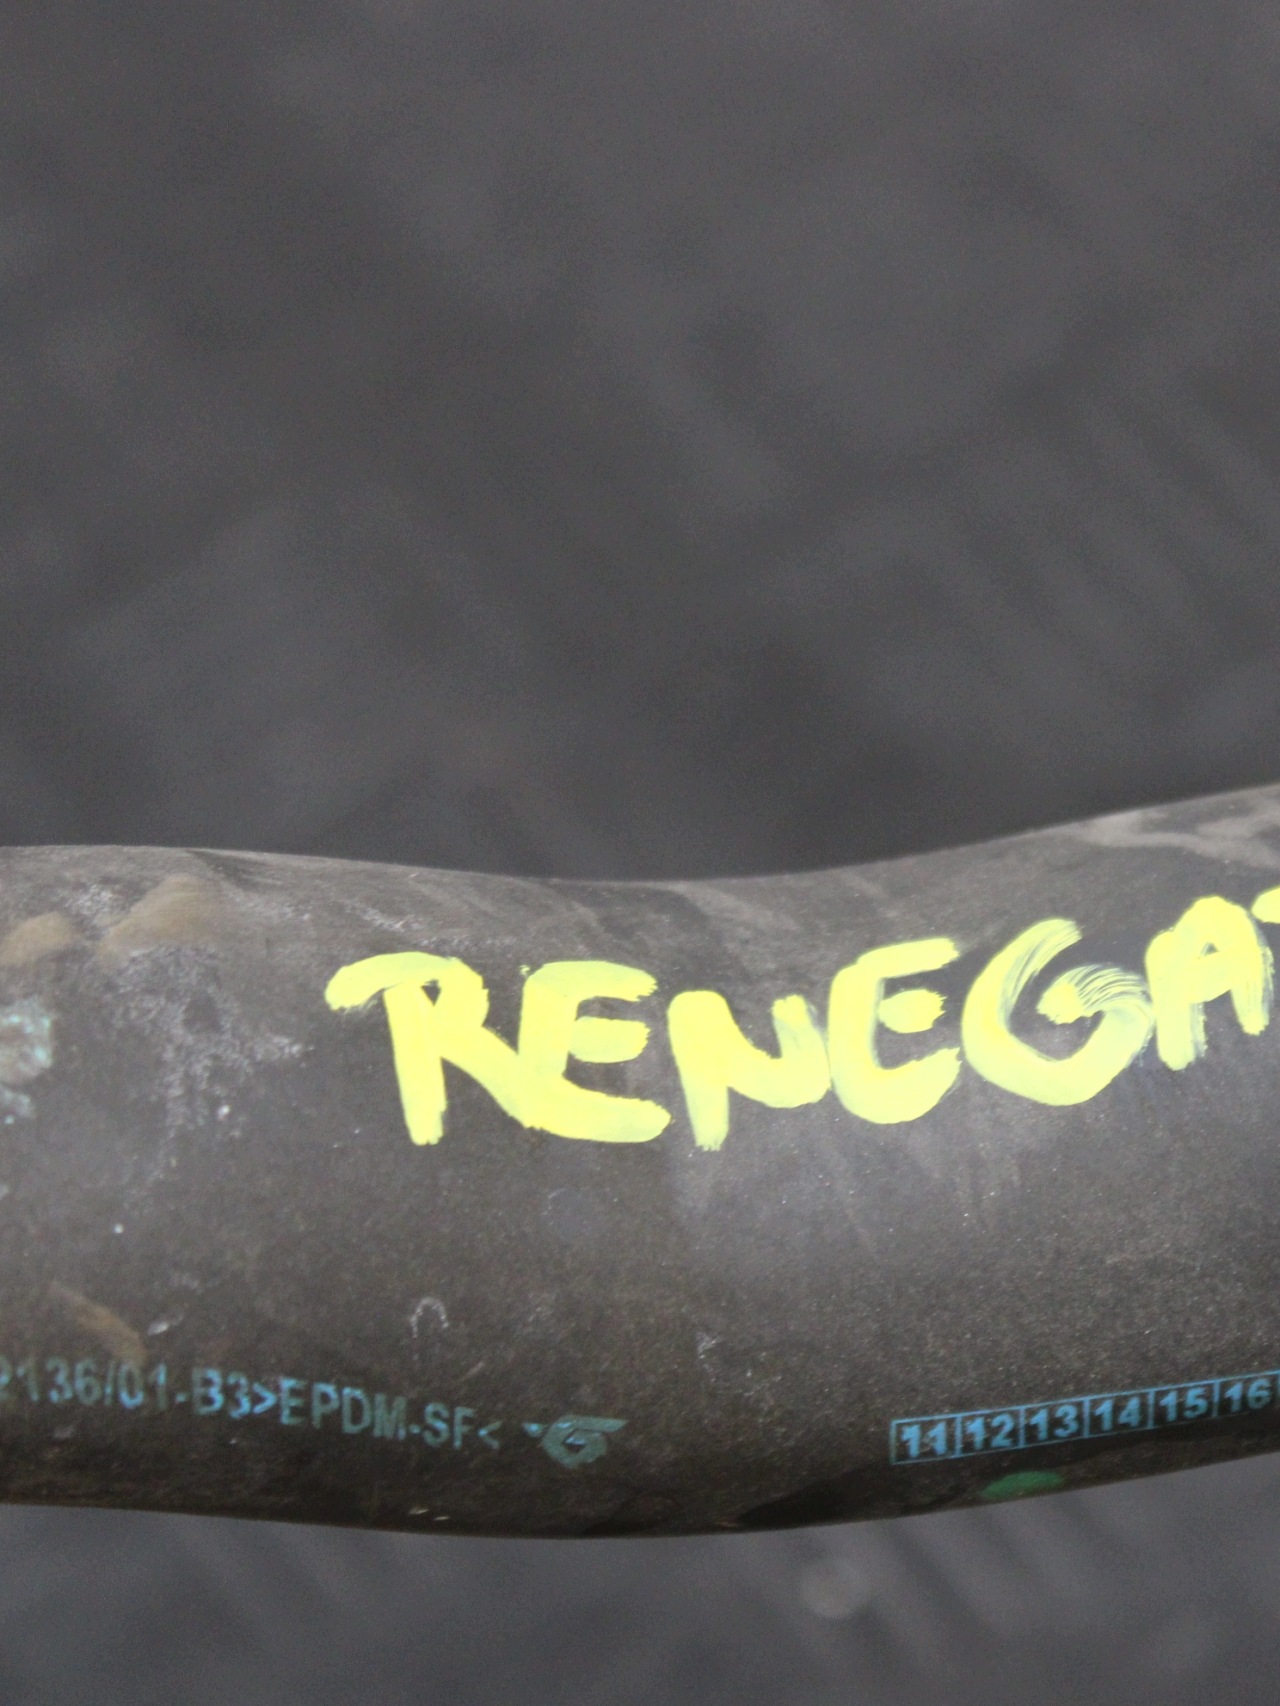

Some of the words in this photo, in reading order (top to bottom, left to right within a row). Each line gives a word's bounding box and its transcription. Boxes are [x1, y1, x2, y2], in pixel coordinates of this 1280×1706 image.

[901, 1423, 952, 1458] 11
[964, 1416, 1015, 1450] 12
[1029, 1406, 1080, 1442] 13
[1094, 1397, 1142, 1432] 14
[1159, 1388, 1208, 1421] 15
[1224, 1378, 1272, 1410] 16
